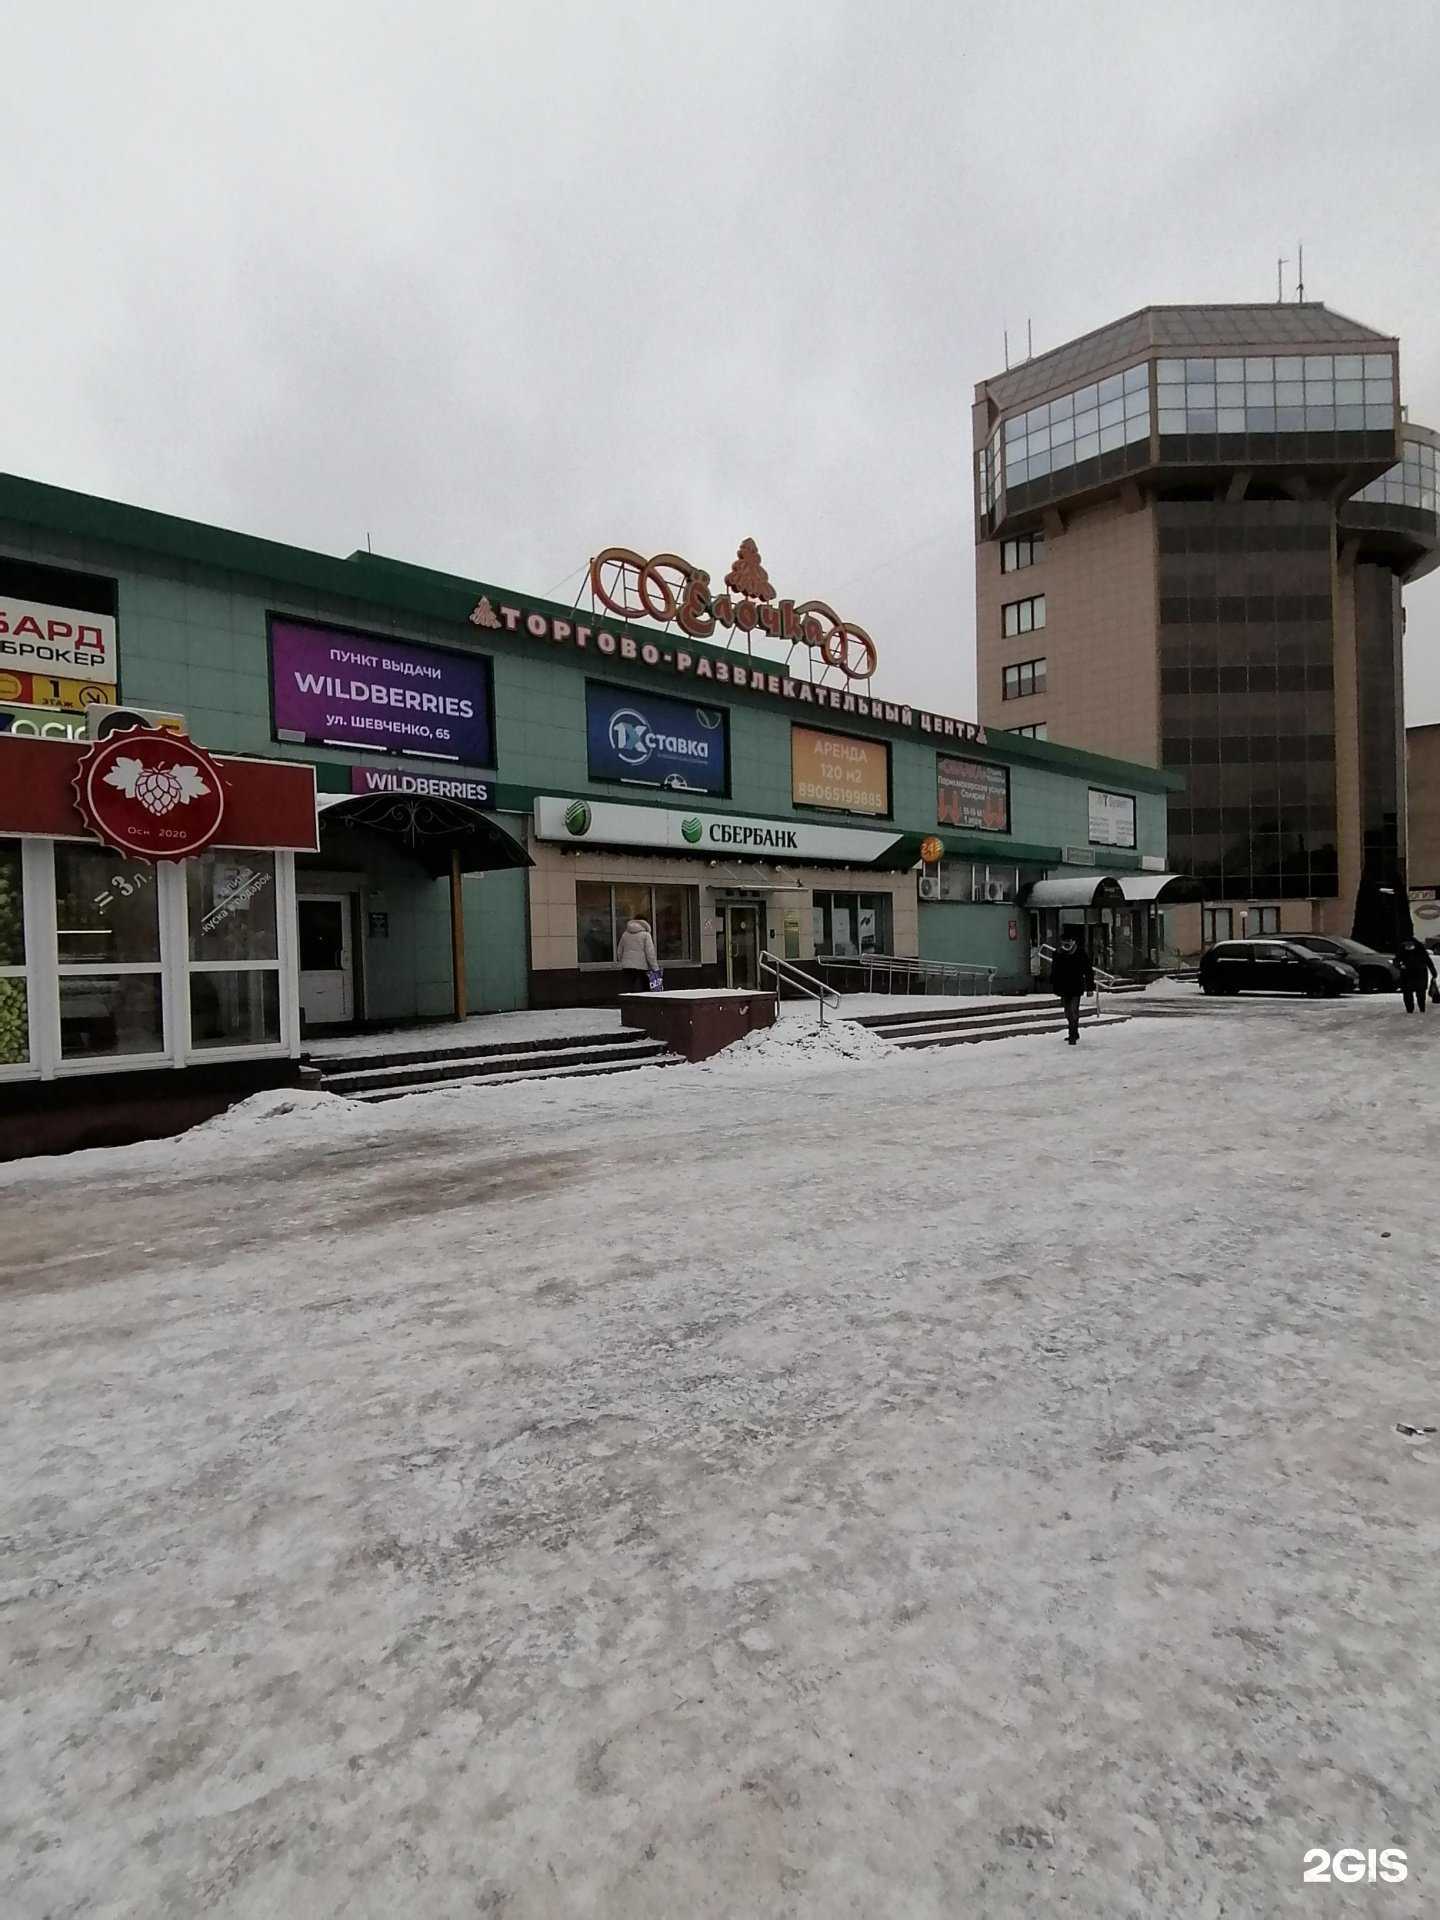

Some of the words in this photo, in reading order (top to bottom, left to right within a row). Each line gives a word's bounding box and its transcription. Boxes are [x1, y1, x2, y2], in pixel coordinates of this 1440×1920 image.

[330, 648, 378, 668] ПУНКТ
[382, 658, 442, 680] ВЫДАЧИ
[50, 680, 60, 698] 1
[294, 671, 475, 718] WILDBERRIES
[326, 713, 347, 726] ул.
[351, 714, 434, 741] ШЕВЧЕНКО,
[436, 727, 451, 740] 65
[920, 712, 977, 739] ЦЕНТР
[814, 740, 868, 764] АРЕНДА
[821, 764, 842, 778] 120
[366, 772, 488, 801] WILDBERRIES
[159, 828, 187, 839] 2020
[710, 823, 798, 849] СБЕРБАНК
